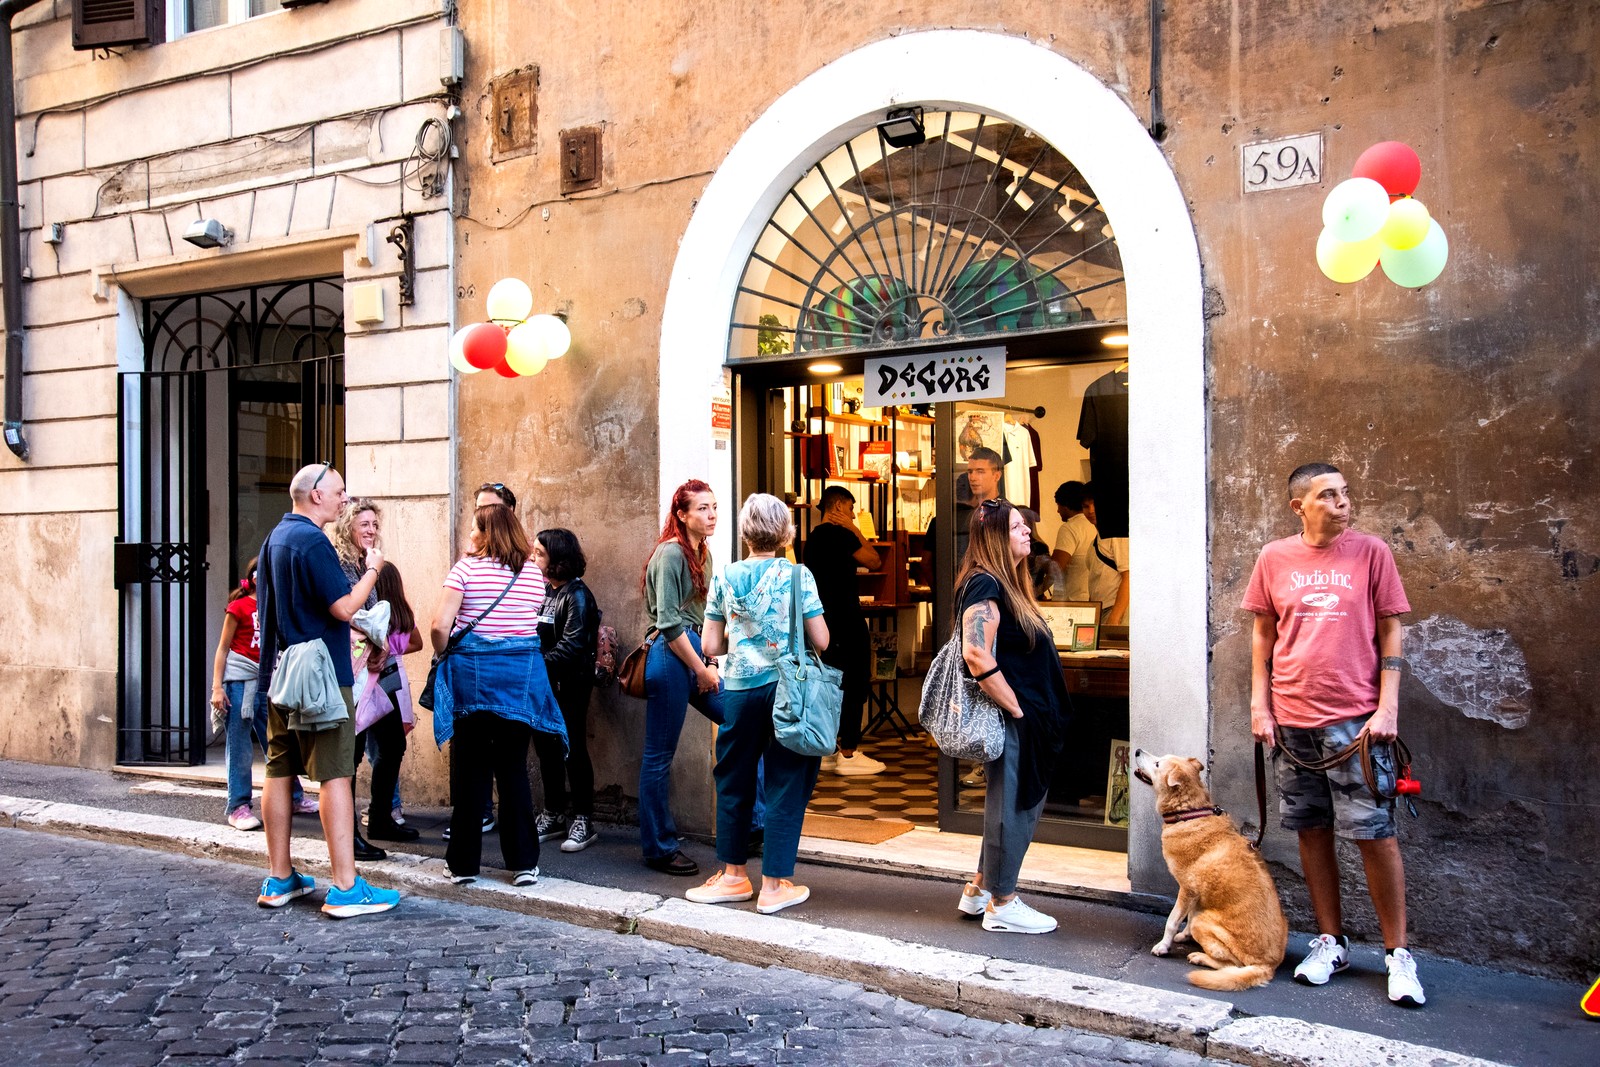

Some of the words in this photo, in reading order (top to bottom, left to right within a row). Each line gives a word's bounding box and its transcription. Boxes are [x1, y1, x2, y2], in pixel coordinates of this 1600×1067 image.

[1248, 145, 1318, 186] 59A
[877, 360, 990, 396] DECORE
[1290, 569, 1329, 591] Studio
